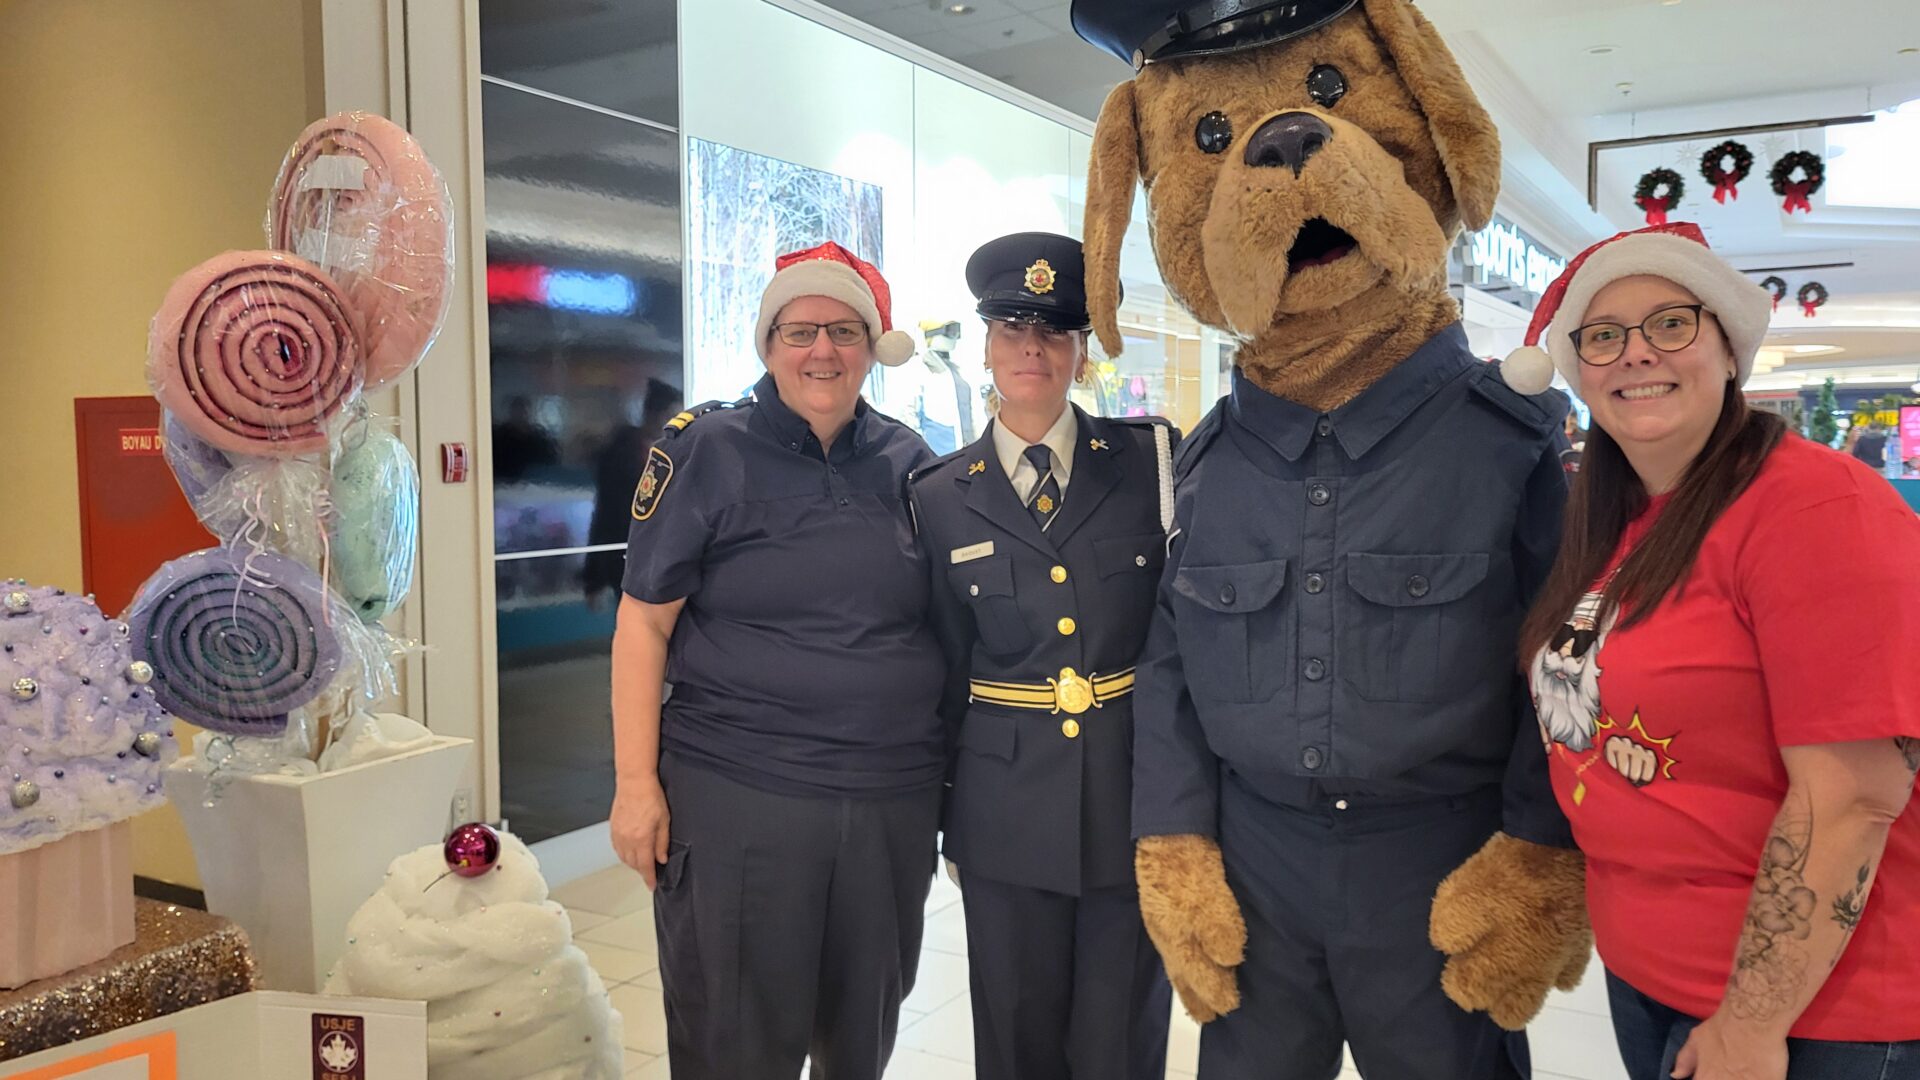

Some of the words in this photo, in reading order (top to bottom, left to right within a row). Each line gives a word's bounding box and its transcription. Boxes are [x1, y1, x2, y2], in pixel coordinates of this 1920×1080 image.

[1472, 221, 1525, 287] sports
[122, 435, 152, 450] BOYAU
[320, 1017, 356, 1031] USJE
